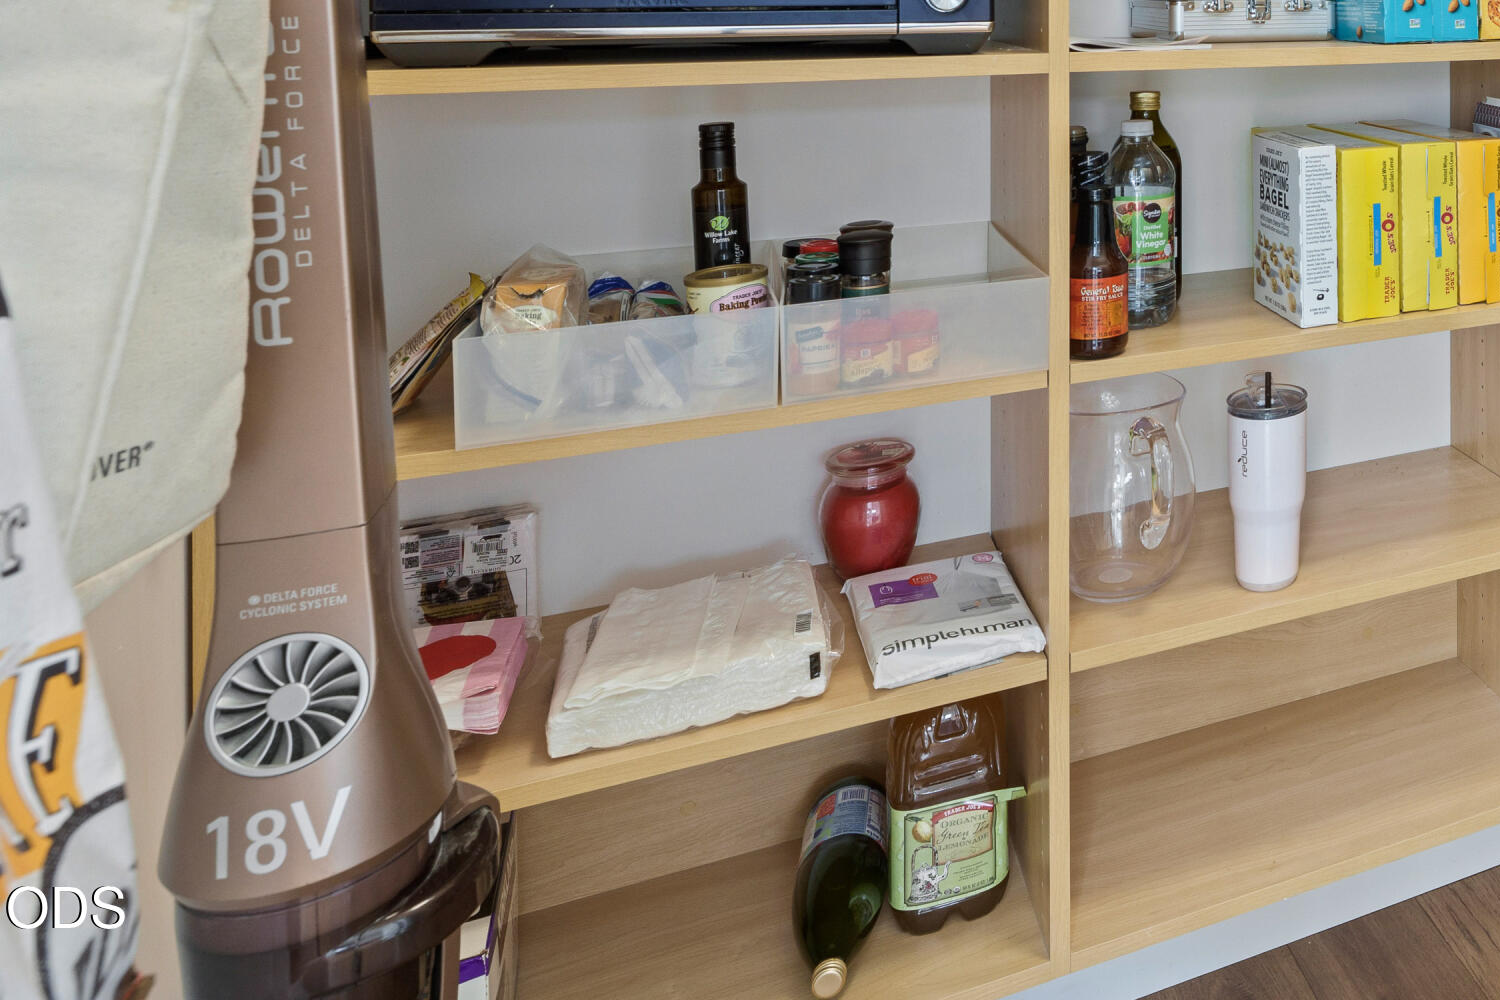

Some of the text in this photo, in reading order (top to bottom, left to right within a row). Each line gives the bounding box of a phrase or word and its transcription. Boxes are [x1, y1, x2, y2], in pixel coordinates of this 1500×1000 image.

[282, 15, 312, 267] DELTA FORCE
[1260, 154, 1289, 176] MINI (ALMOST)
[1260, 169, 1289, 192] EVERYTHING
[1260, 184, 1289, 209] BAGEL
[1136, 239, 1166, 249] Vinegar
[1140, 231, 1163, 240] White
[733, 292, 751, 300] TRADER
[1081, 285, 1109, 296] General
[719, 300, 750, 312] Baking
[1238, 430, 1248, 477] reduce
[263, 583, 339, 604] DELTA FORCE
[240, 594, 348, 620] CYCLONIC SYSTEM
[881, 618, 1032, 656] simplehuman
[941, 813, 987, 829] ORGANIC
[944, 805, 965, 817] TRADER
[205, 785, 352, 880] 18V
[937, 820, 989, 845] Green Tea
[938, 833, 987, 851] LEMONADE
